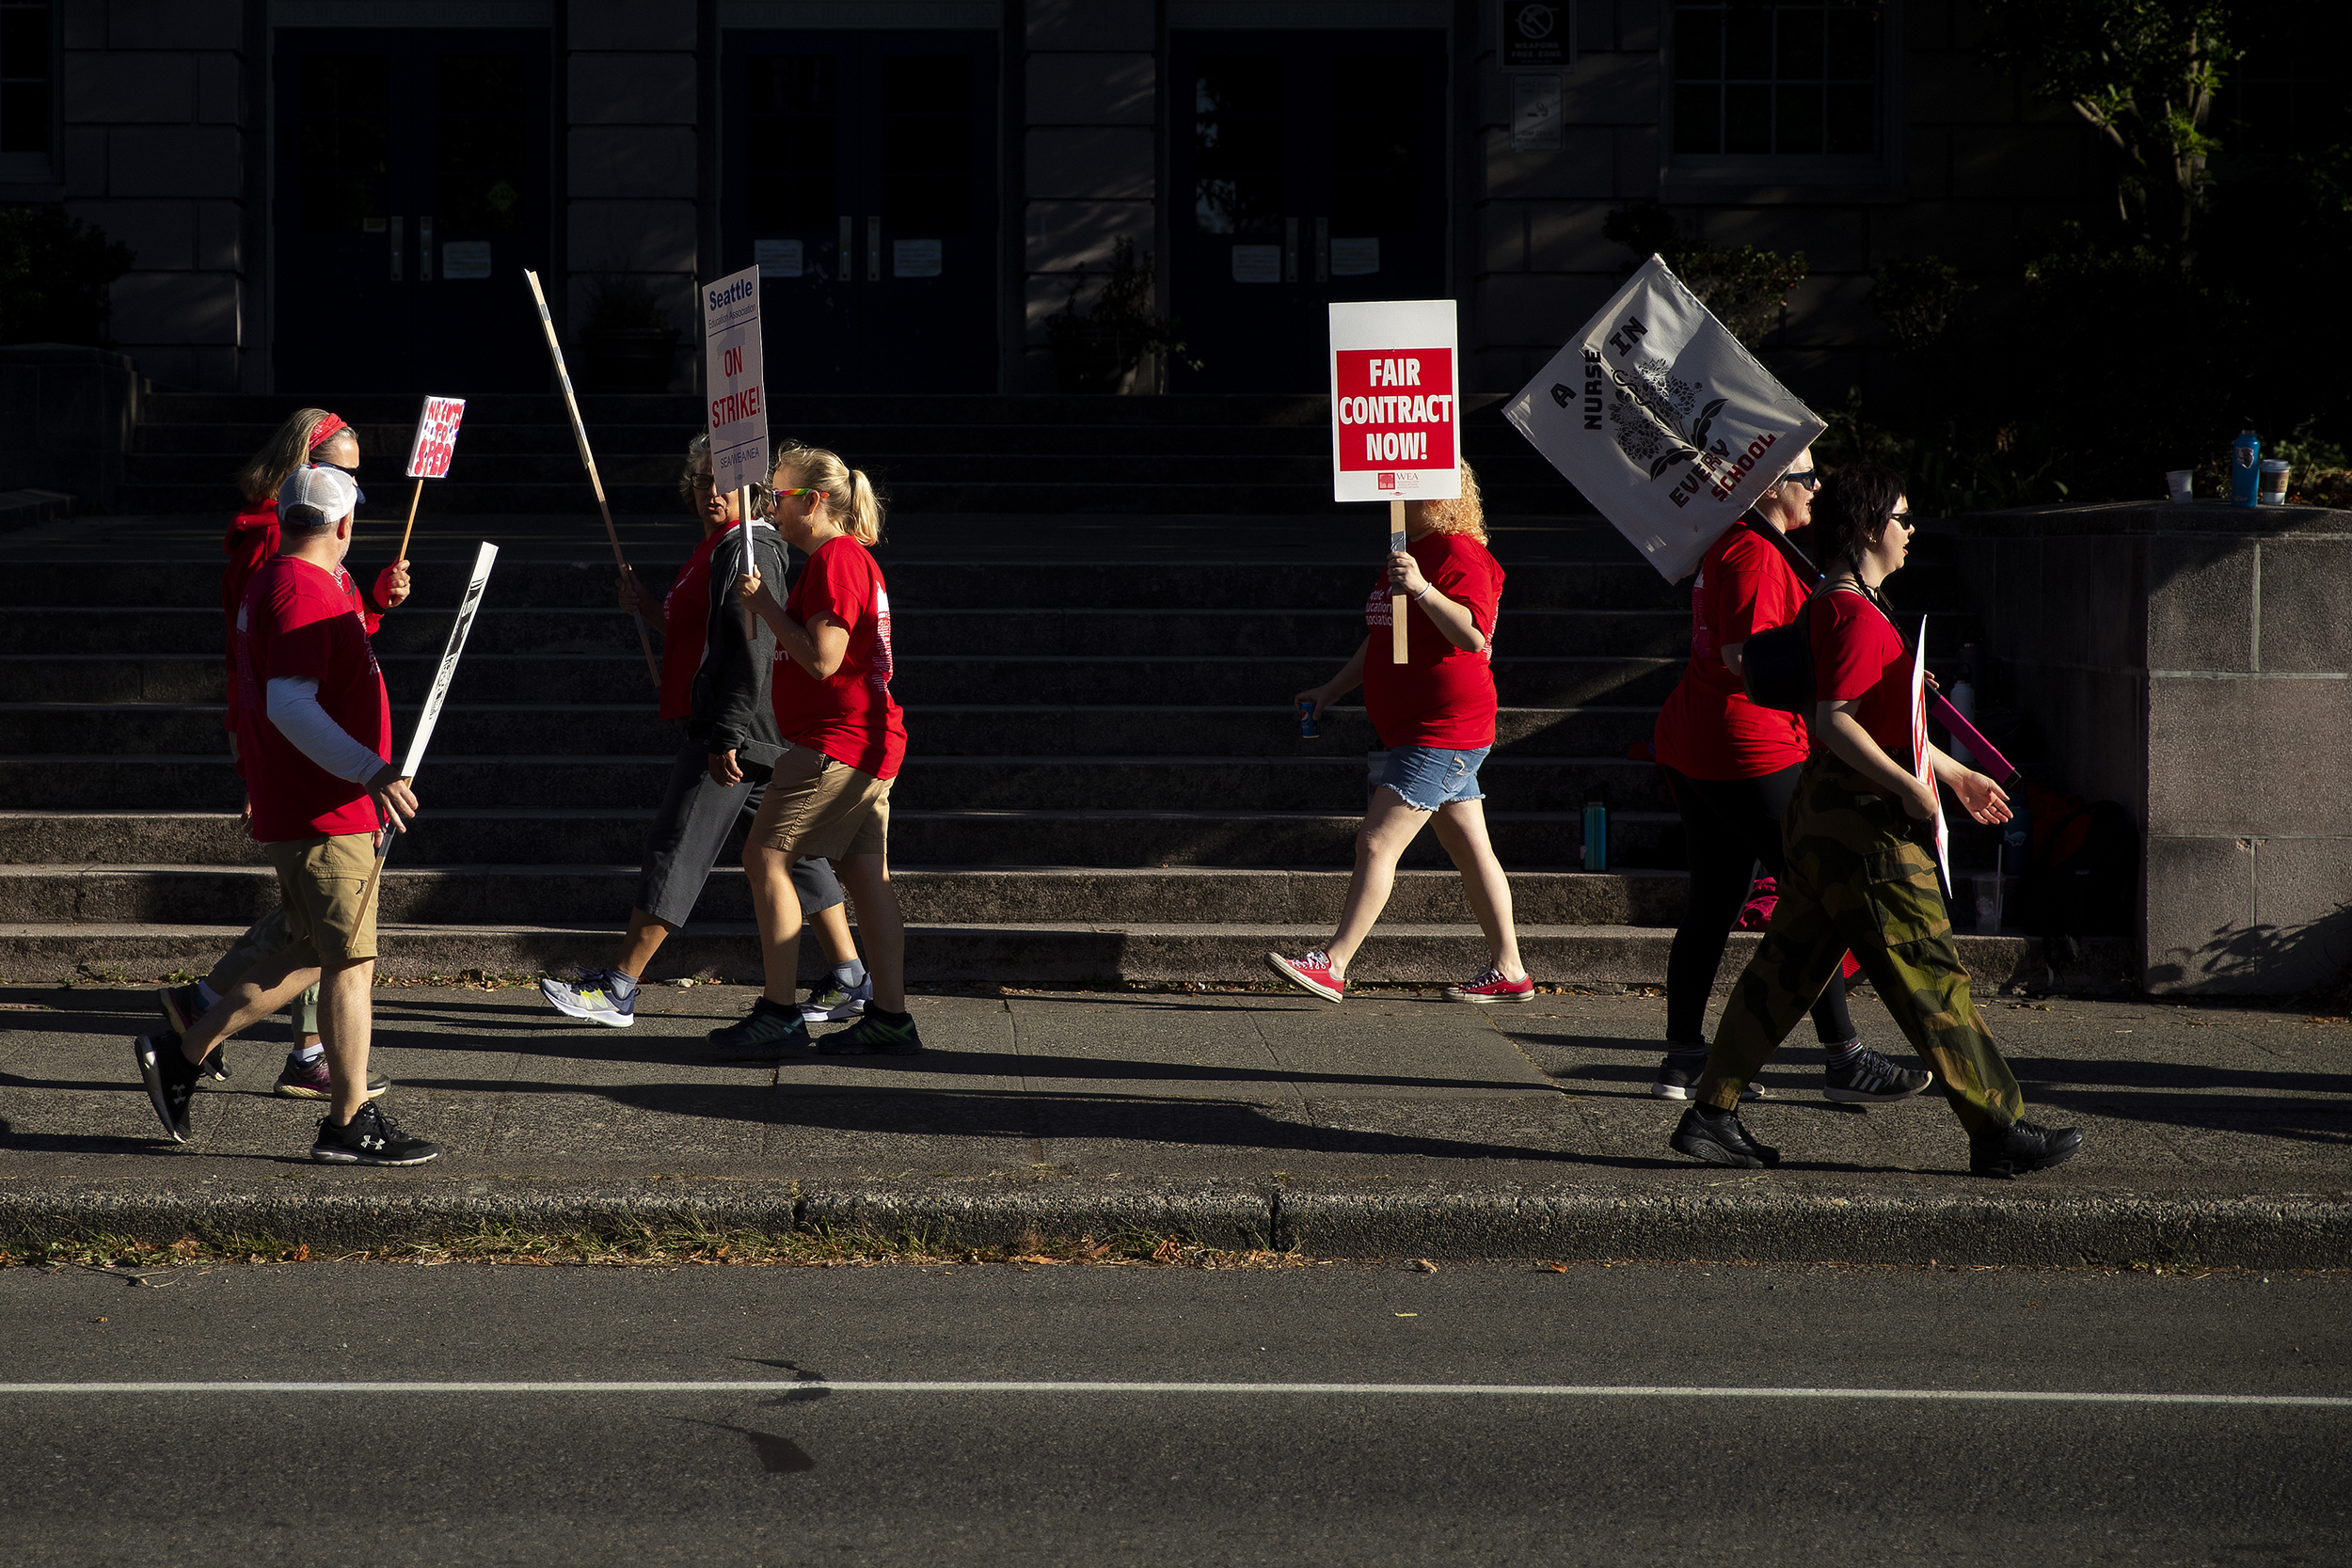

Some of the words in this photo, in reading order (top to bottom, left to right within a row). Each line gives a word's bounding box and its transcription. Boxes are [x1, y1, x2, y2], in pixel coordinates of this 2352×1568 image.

[709, 278, 753, 311] Seattle
[708, 314, 728, 329] Education
[728, 304, 756, 321] Association
[724, 346, 742, 377] ON
[1369, 358, 1421, 387] FAIR
[1550, 383, 1577, 409] A
[1584, 349, 1603, 431] NURSE
[1609, 316, 1648, 357] IN
[427, 401, 441, 421] NO
[712, 386, 760, 428] STRIKE!
[1339, 394, 1453, 425] CONTRACT
[435, 422, 449, 443] TO
[1366, 432, 1428, 461] NOW!
[414, 439, 452, 477] SPED
[1710, 433, 1777, 502] SCHOOL
[1396, 472, 1419, 481] WEA
[1668, 438, 1730, 509] EVERY
[1365, 601, 1392, 613] ucation
[1365, 614, 1392, 626] sociatio
